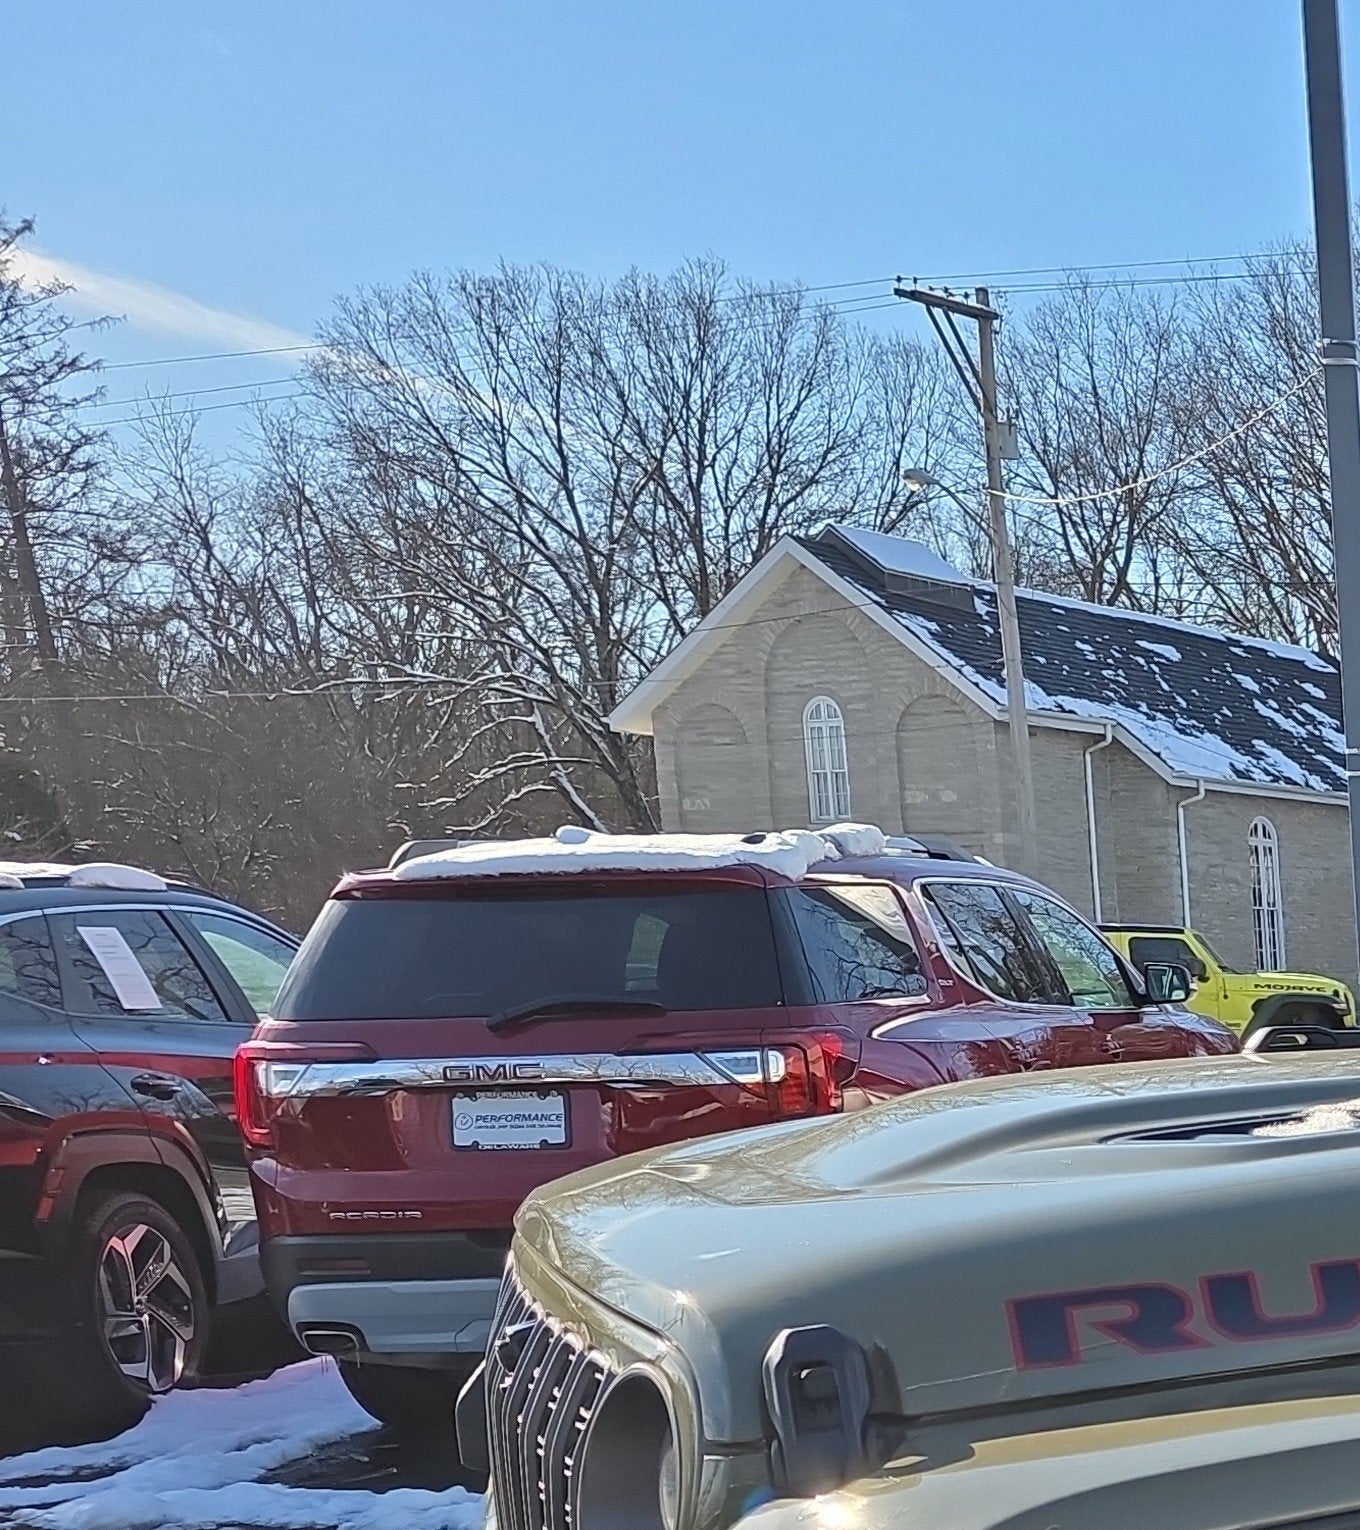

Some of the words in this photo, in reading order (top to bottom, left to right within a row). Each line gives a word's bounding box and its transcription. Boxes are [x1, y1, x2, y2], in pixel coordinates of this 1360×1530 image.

[1253, 983, 1328, 993] MOJAVE
[443, 1062, 546, 1082] GMC
[475, 1091, 538, 1099] PERFORMANCE
[474, 1113, 563, 1124] PERFORMANCE
